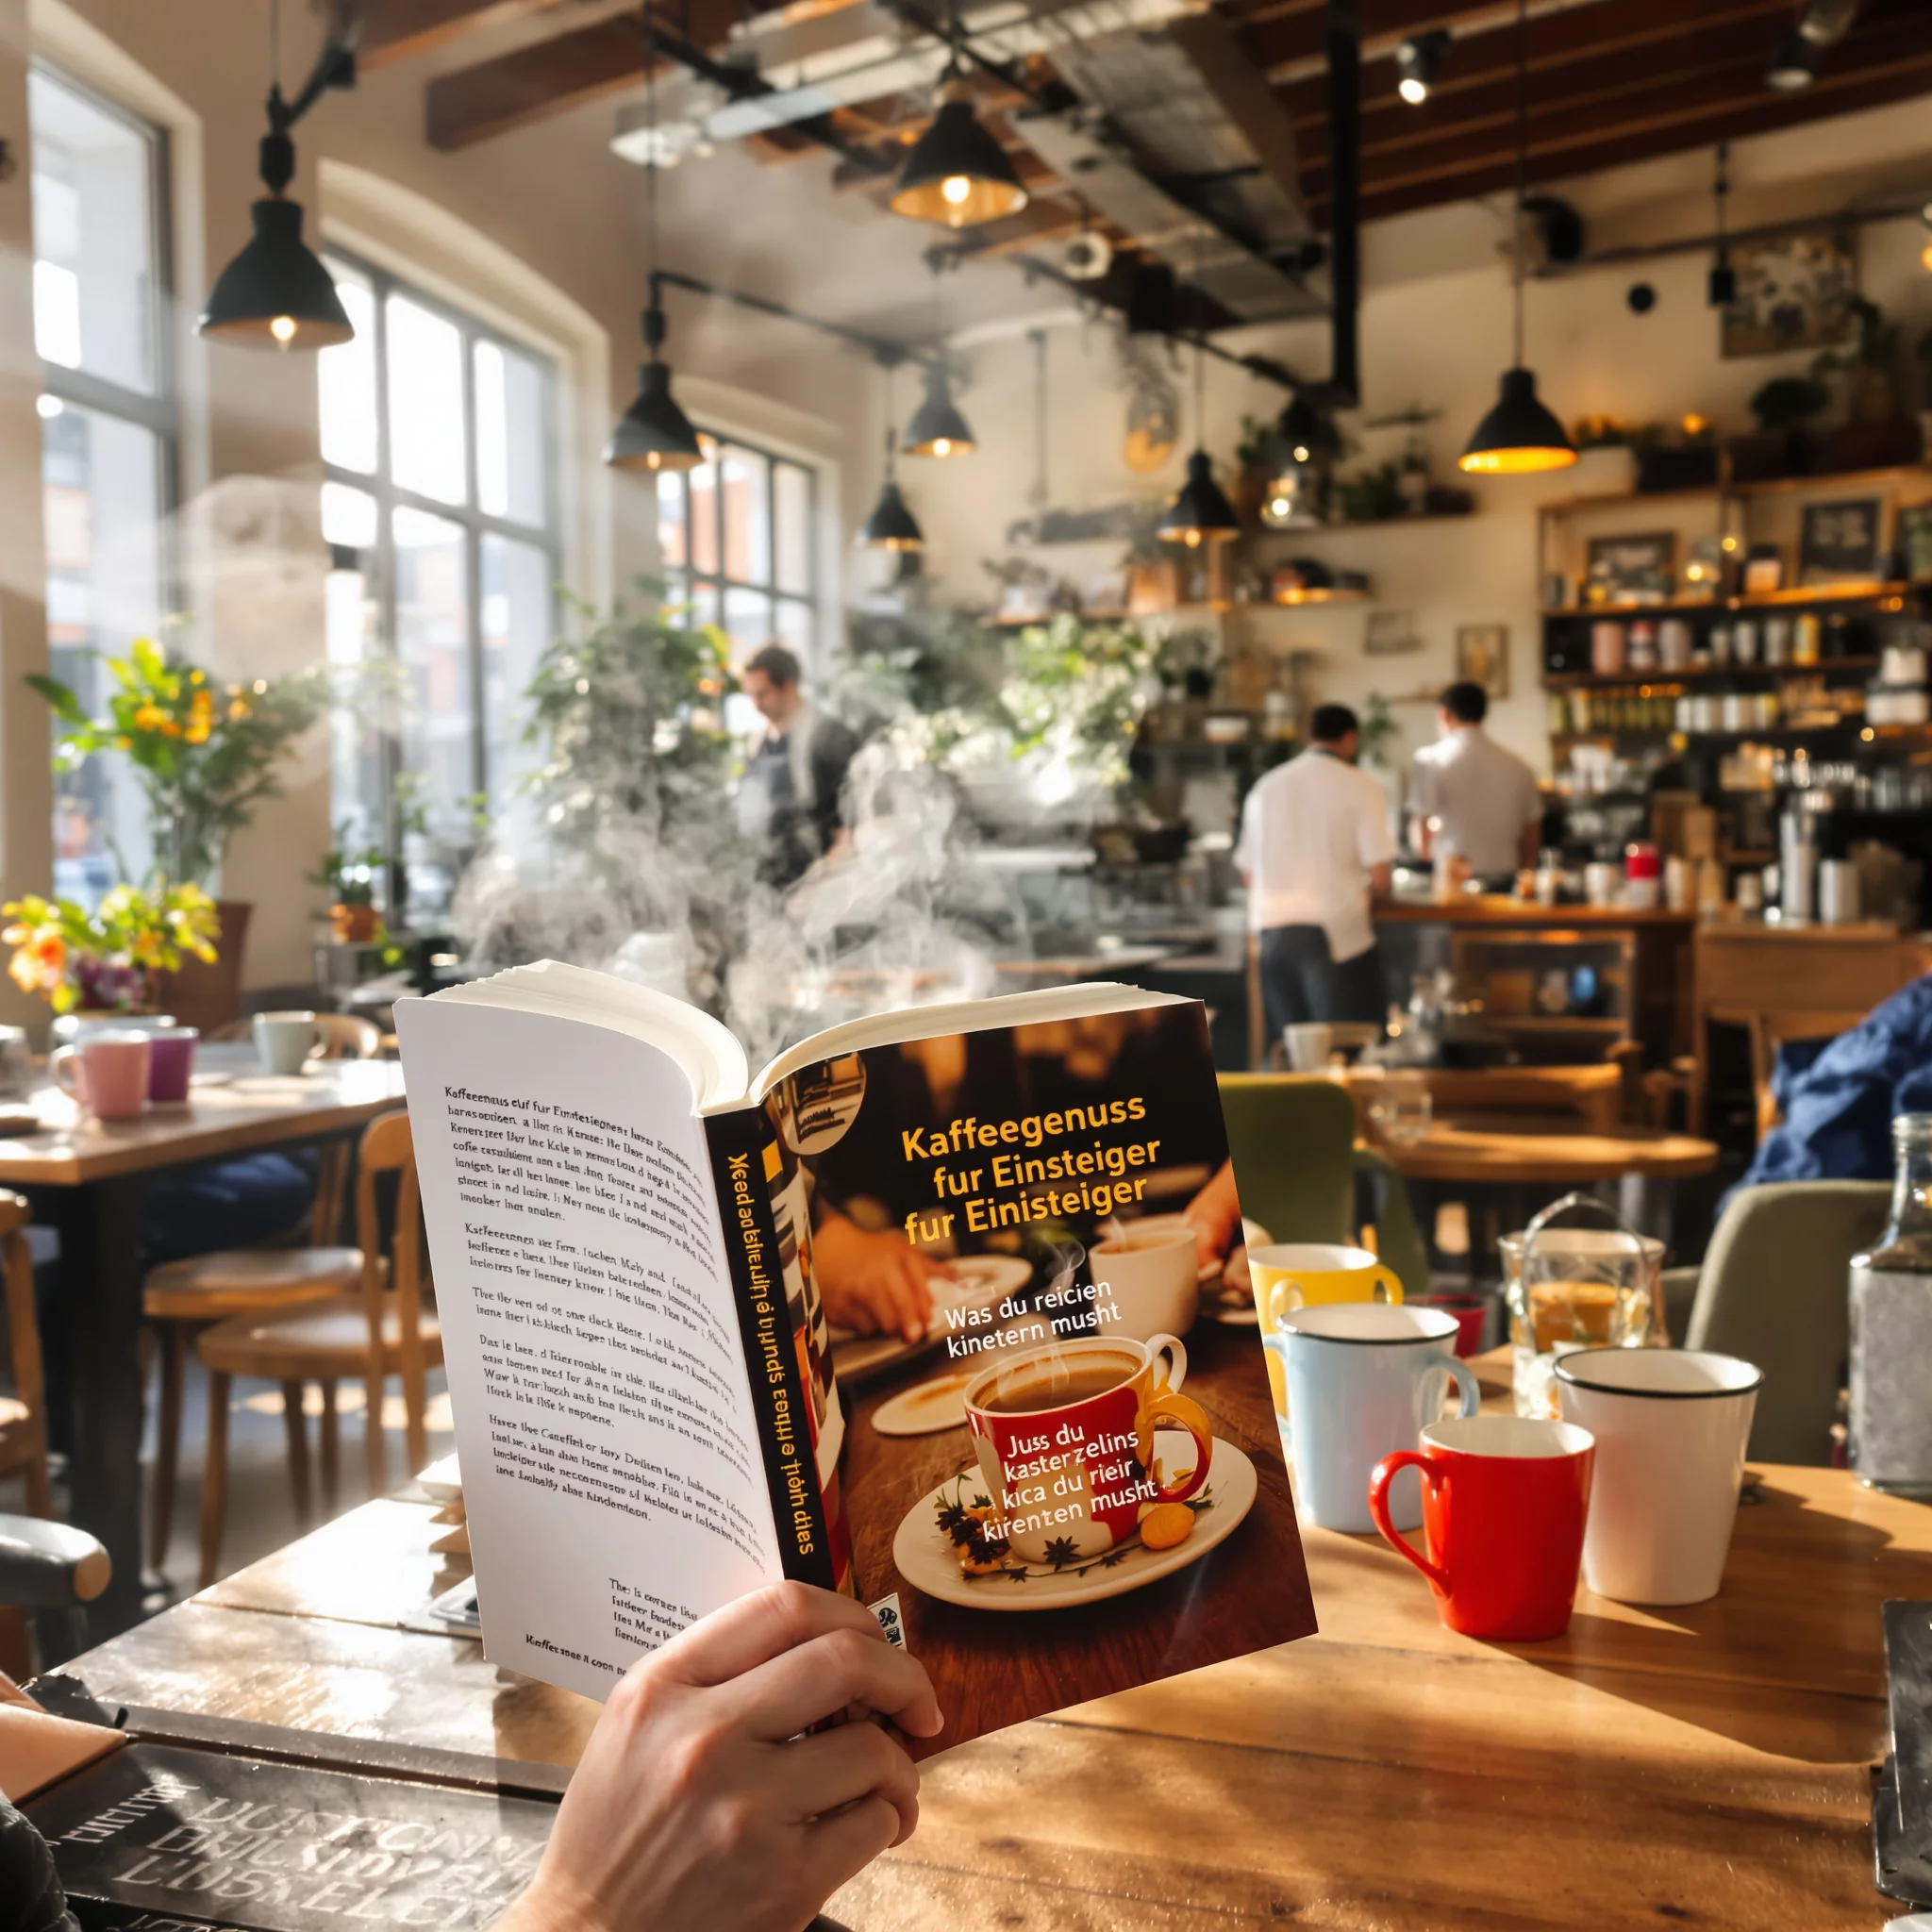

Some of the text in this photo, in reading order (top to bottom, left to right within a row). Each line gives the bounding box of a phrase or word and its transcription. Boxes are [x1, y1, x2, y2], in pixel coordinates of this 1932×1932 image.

[902, 1097, 1146, 1162] Kaffeegenuss
[934, 1140, 1160, 1199] fur Einsteiger
[905, 1178, 1148, 1245] fur Einisteiger
[944, 1281, 1111, 1330] Was du reicien
[946, 1302, 1122, 1358] kinetern musht
[1007, 1423, 1085, 1458] Juss du
[1002, 1486, 1046, 1509] kica
[1054, 1474, 1083, 1497] du
[1091, 1478, 1158, 1513] musht
